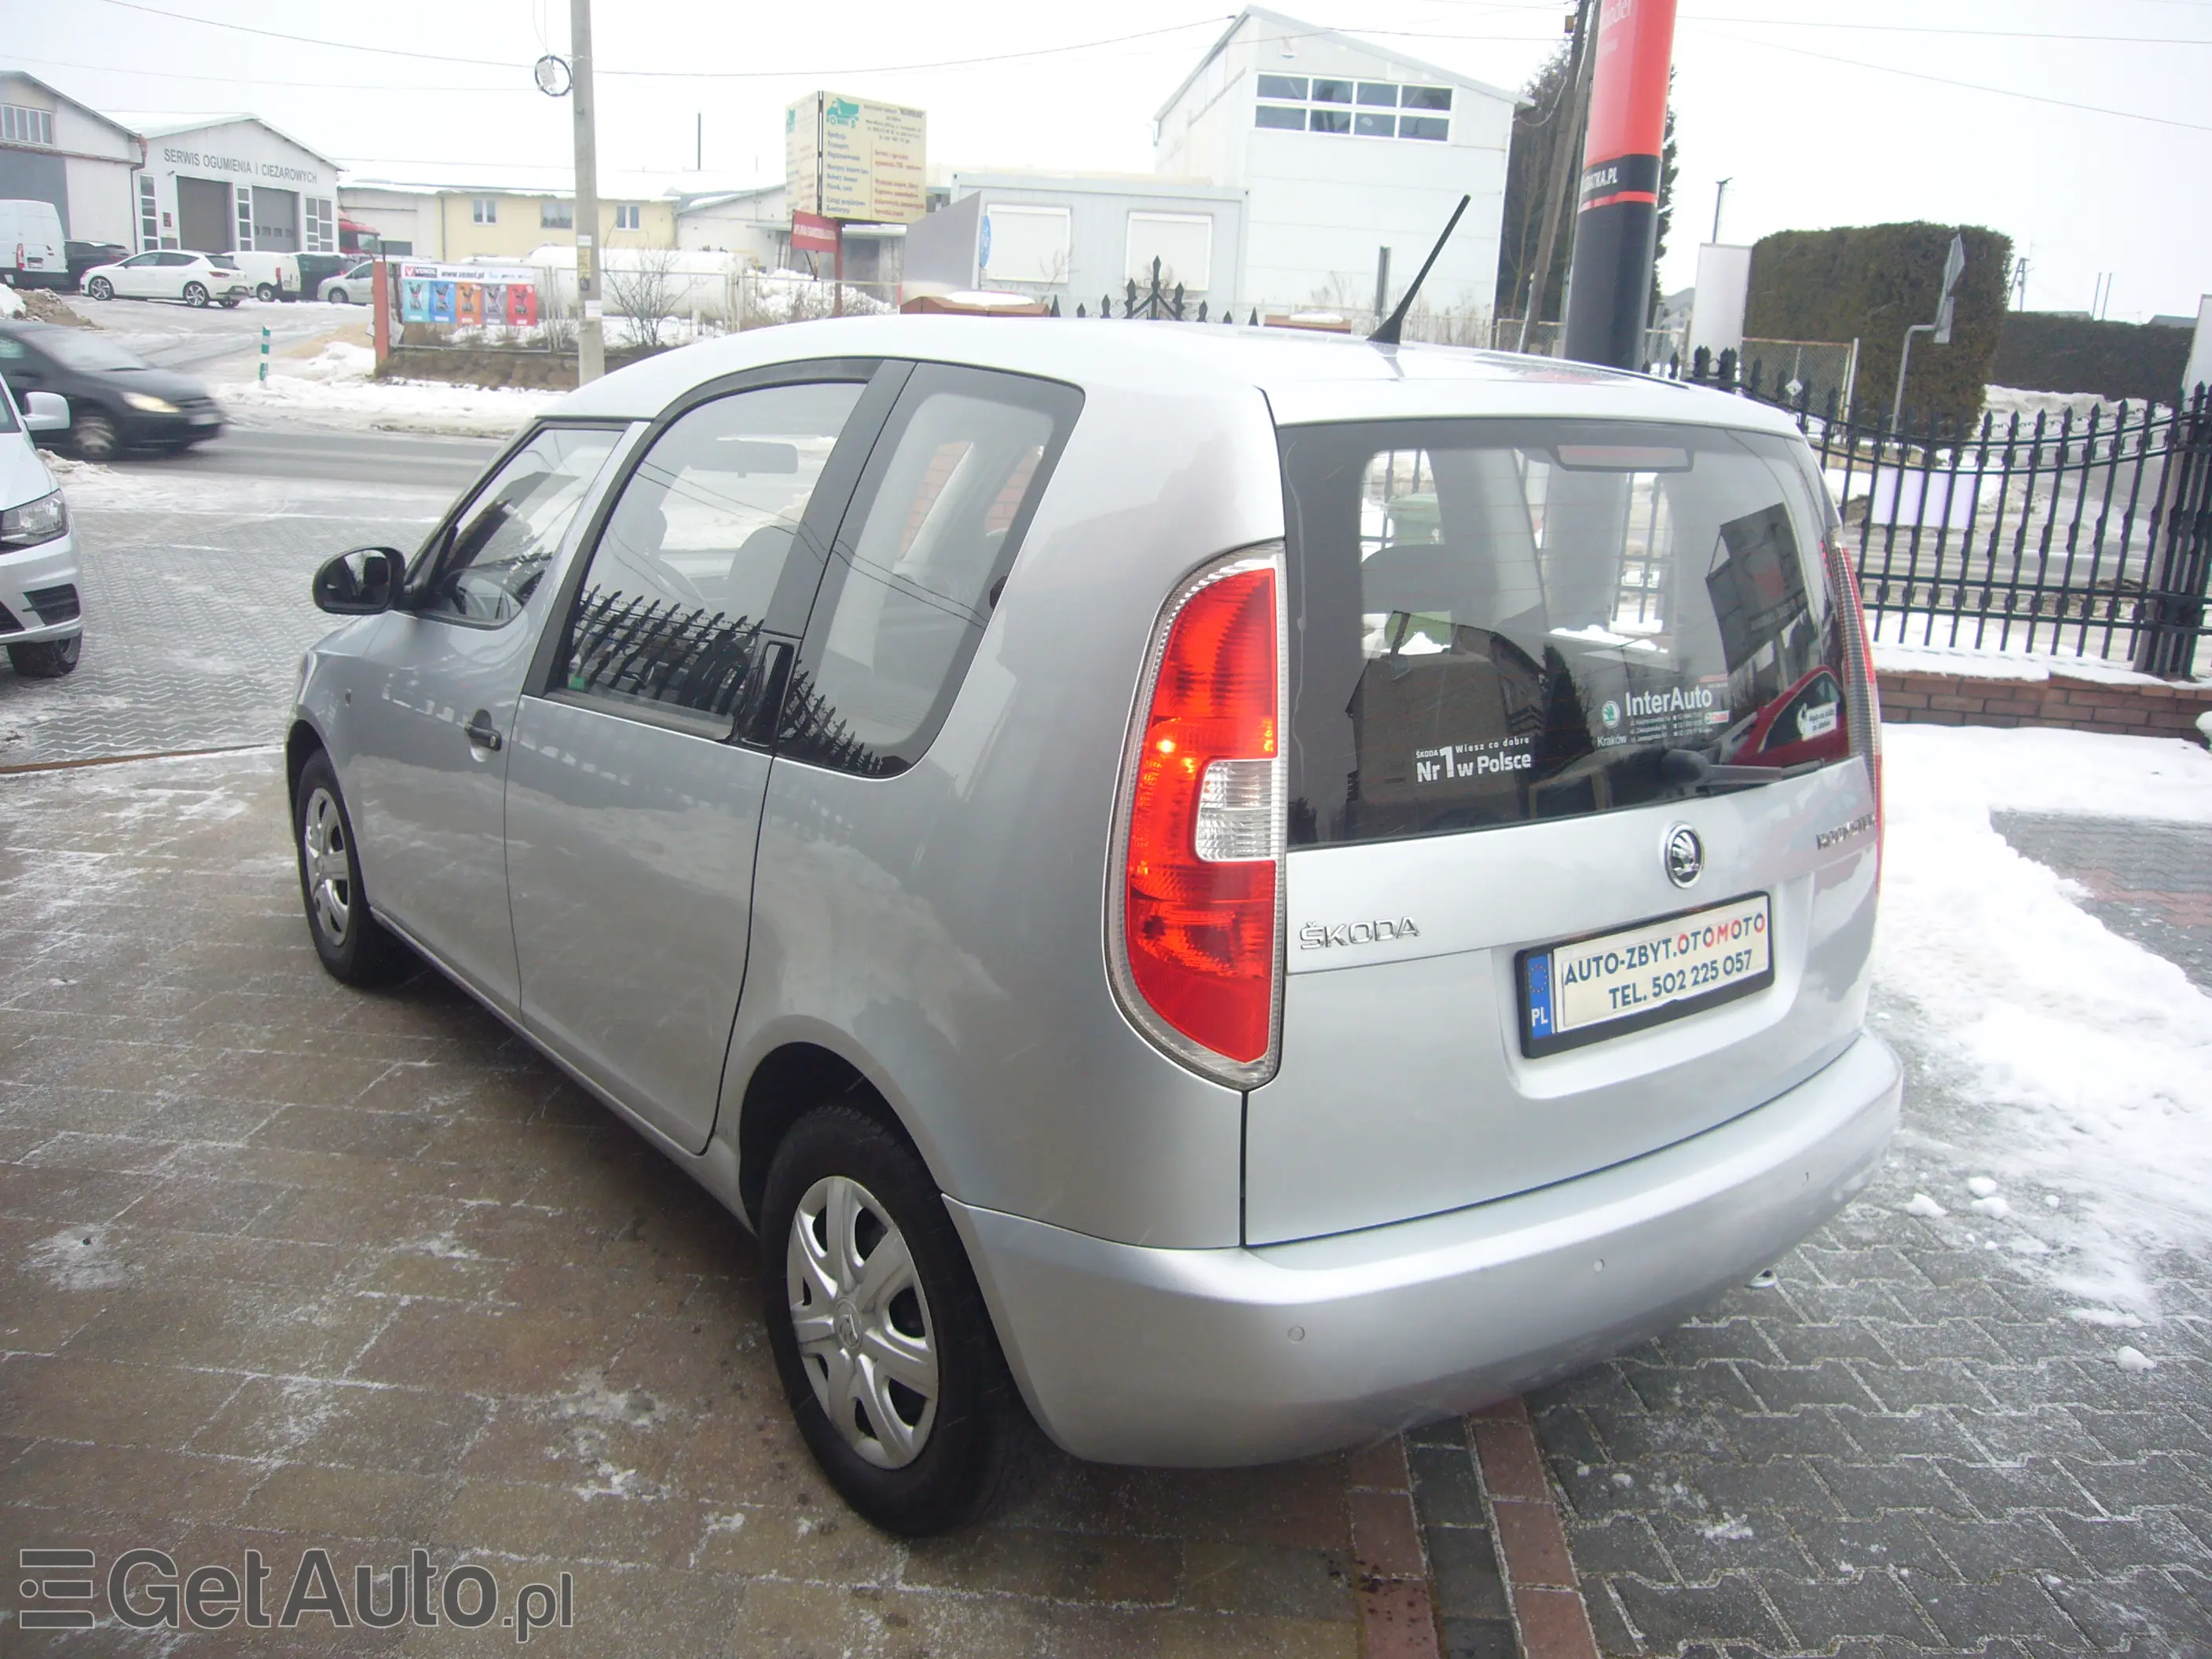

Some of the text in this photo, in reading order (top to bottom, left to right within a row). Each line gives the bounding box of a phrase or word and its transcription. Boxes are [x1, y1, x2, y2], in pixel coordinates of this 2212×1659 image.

[163, 148, 200, 167] SERWIS
[203, 154, 252, 174] OGUMIENIA
[255, 163, 259, 175] I
[1625, 685, 1712, 716] InterAuto
[1456, 745, 1485, 753] Wiesz
[1503, 736, 1529, 746] dobre
[1416, 746, 1532, 782] Nr 1 w Polsce
[1300, 916, 1420, 950] ŠKODA
[1564, 913, 1766, 987] AUTO-ZBYT.OTOMOTO
[1609, 948, 1752, 1009] TEL. 502 225 057
[1532, 1005, 1549, 1028] PL
